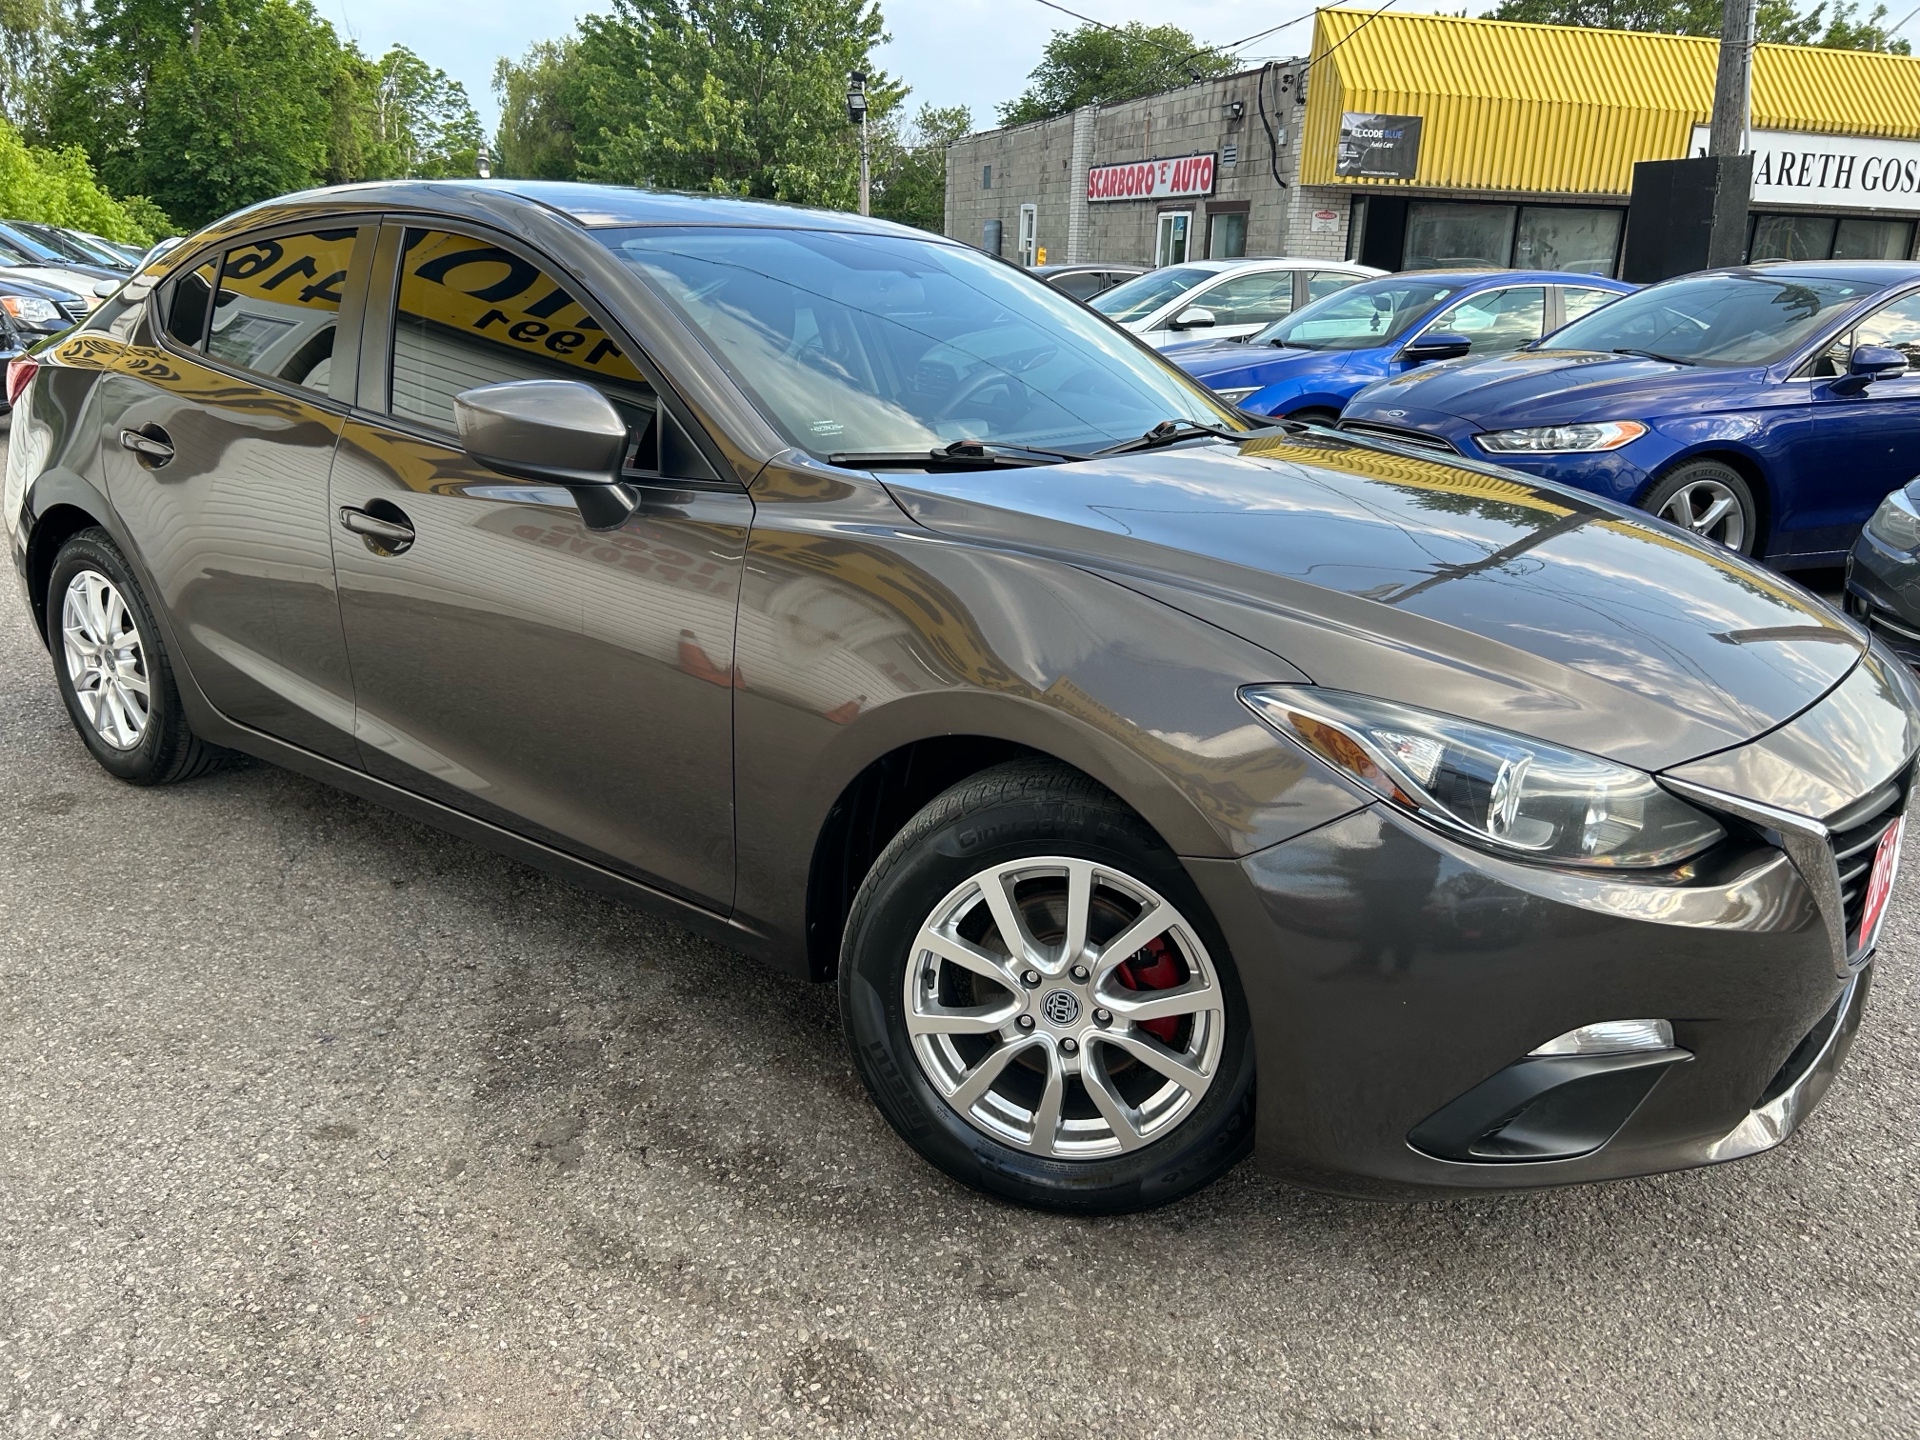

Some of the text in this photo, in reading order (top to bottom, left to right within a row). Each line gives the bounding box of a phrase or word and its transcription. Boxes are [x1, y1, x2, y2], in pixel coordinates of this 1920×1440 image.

[1384, 130, 1403, 139] BLUE
[1383, 141, 1394, 149] Care
[1698, 147, 1920, 193] ARETH GOS
[1088, 163, 1156, 199] SCARBORO
[1169, 156, 1212, 193] AUTO
[1695, 468, 1735, 482] MICHELIN
